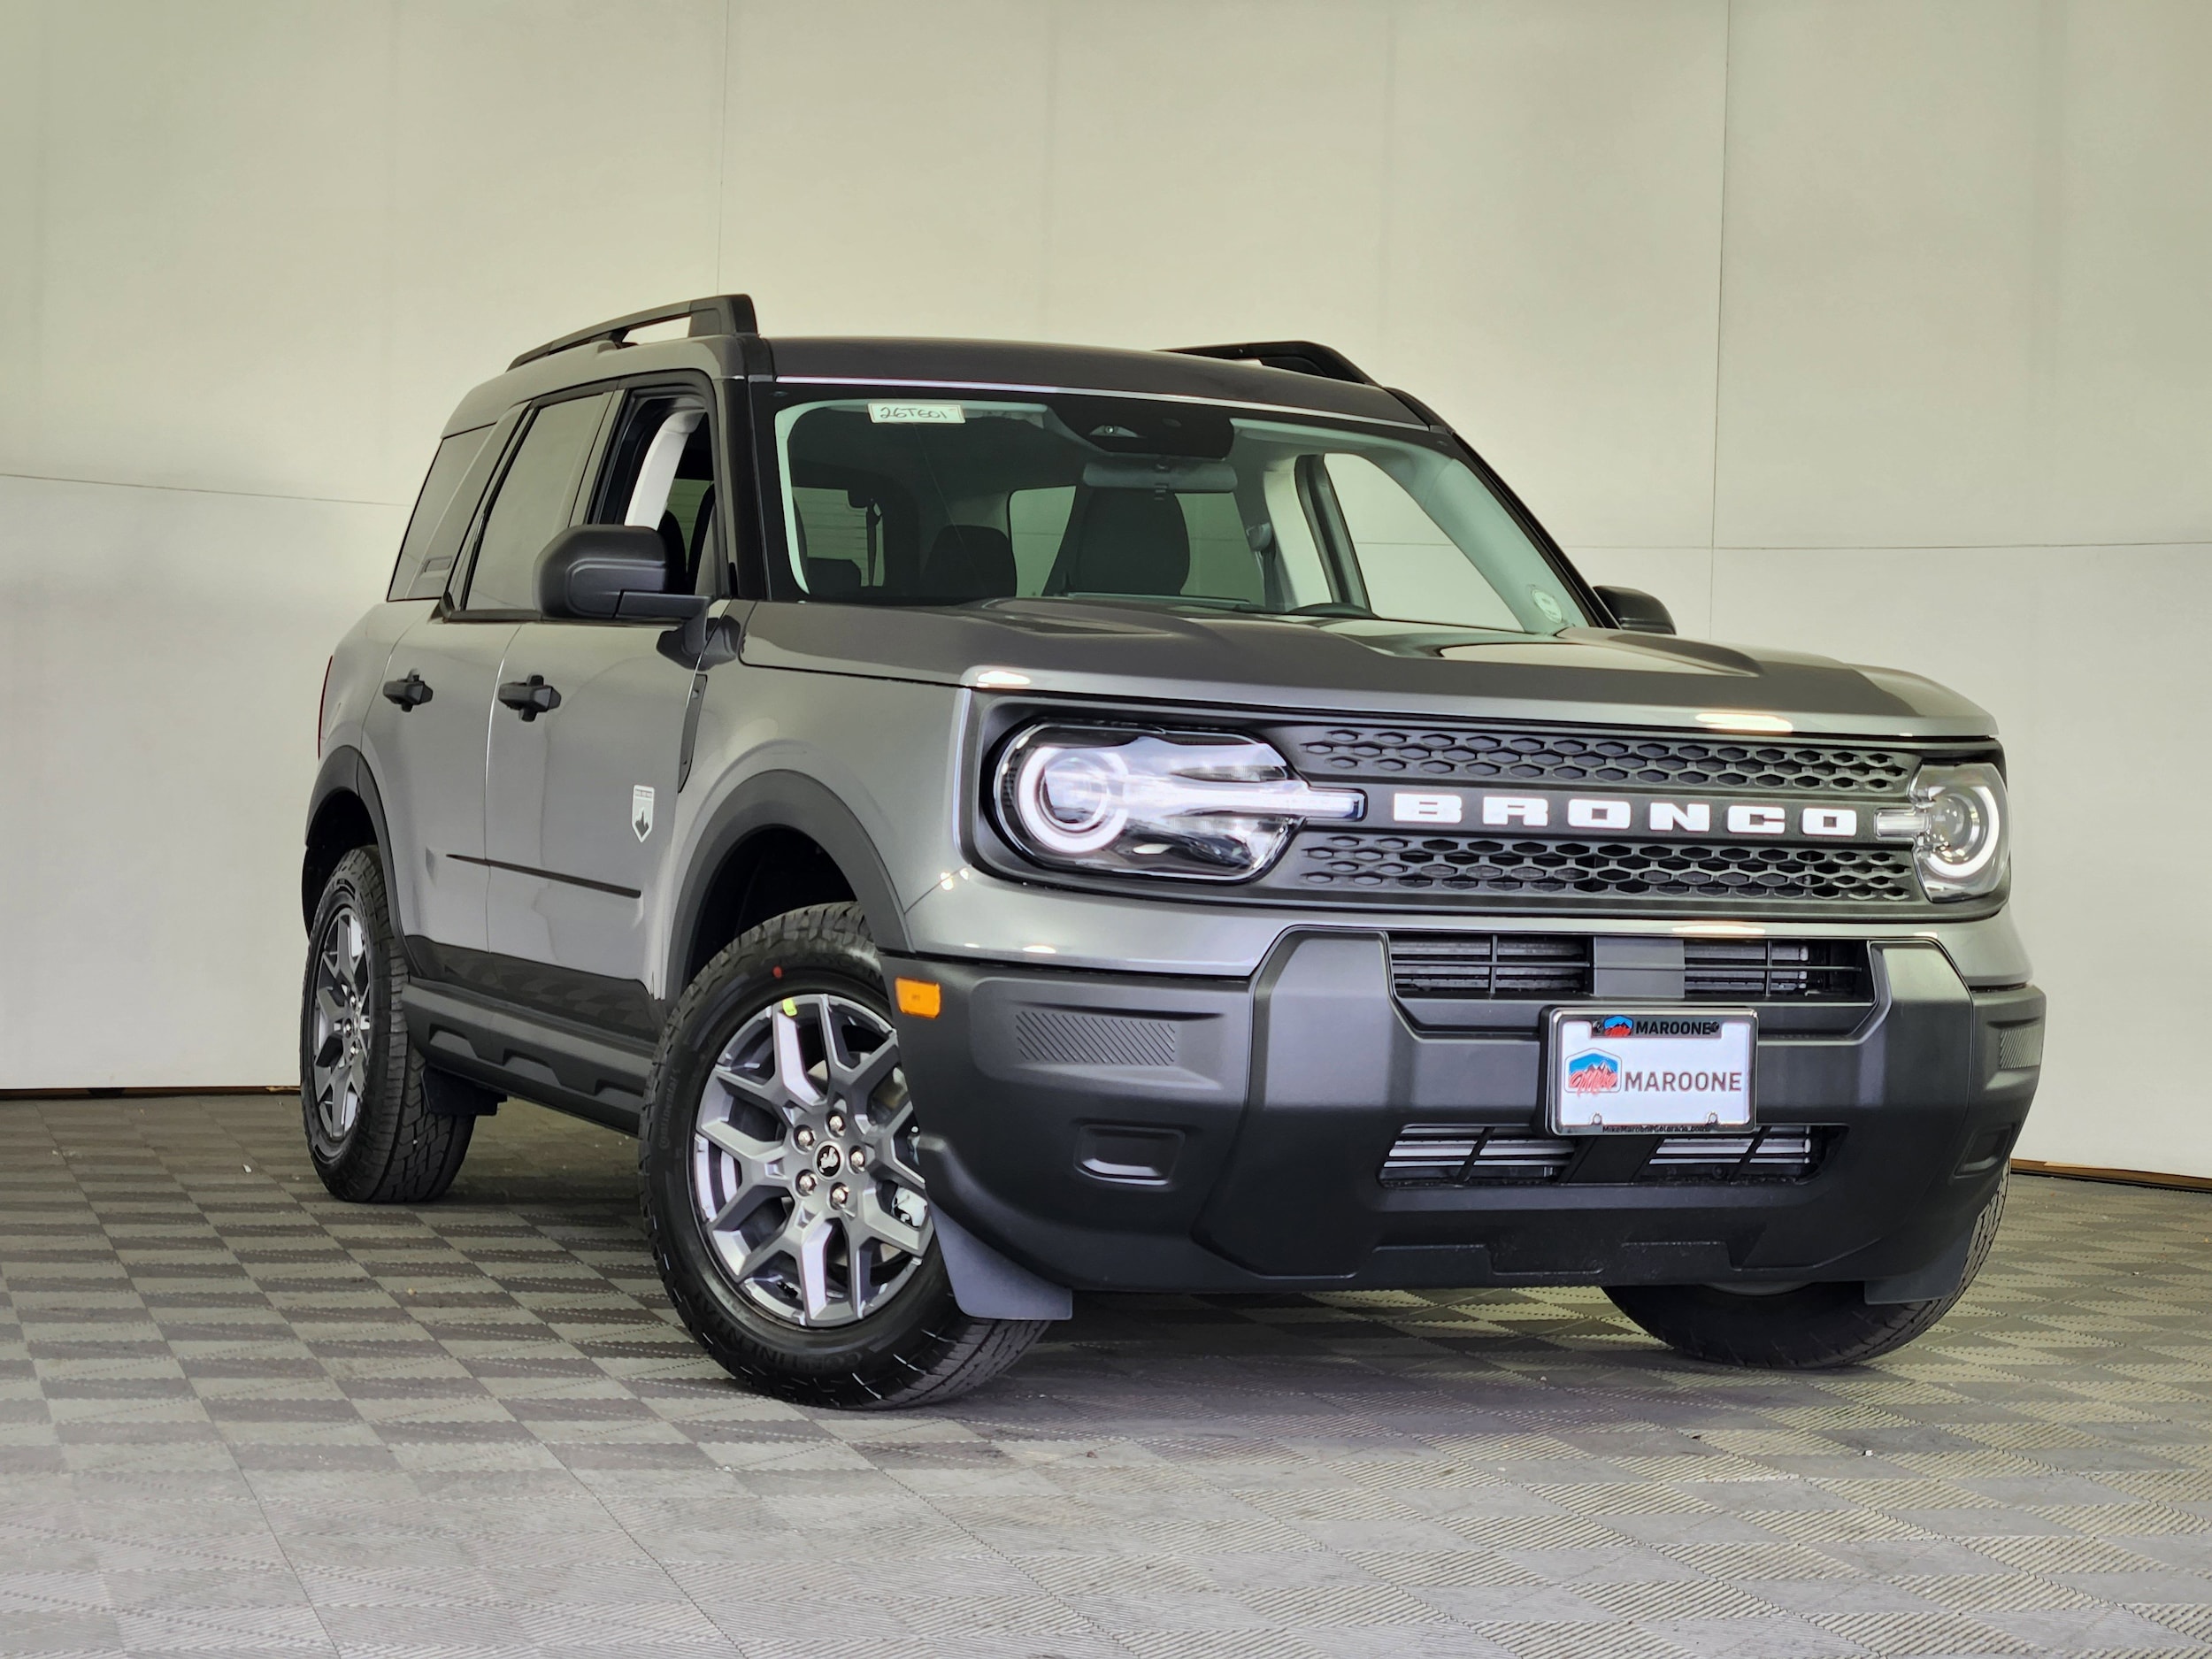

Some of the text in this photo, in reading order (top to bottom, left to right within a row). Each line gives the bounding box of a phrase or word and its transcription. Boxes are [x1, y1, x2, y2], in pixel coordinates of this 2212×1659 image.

[1394, 793, 1858, 835] BRONCO
[1636, 1021, 1711, 1035] MAROONE
[1624, 1071, 1742, 1092] MAROONE
